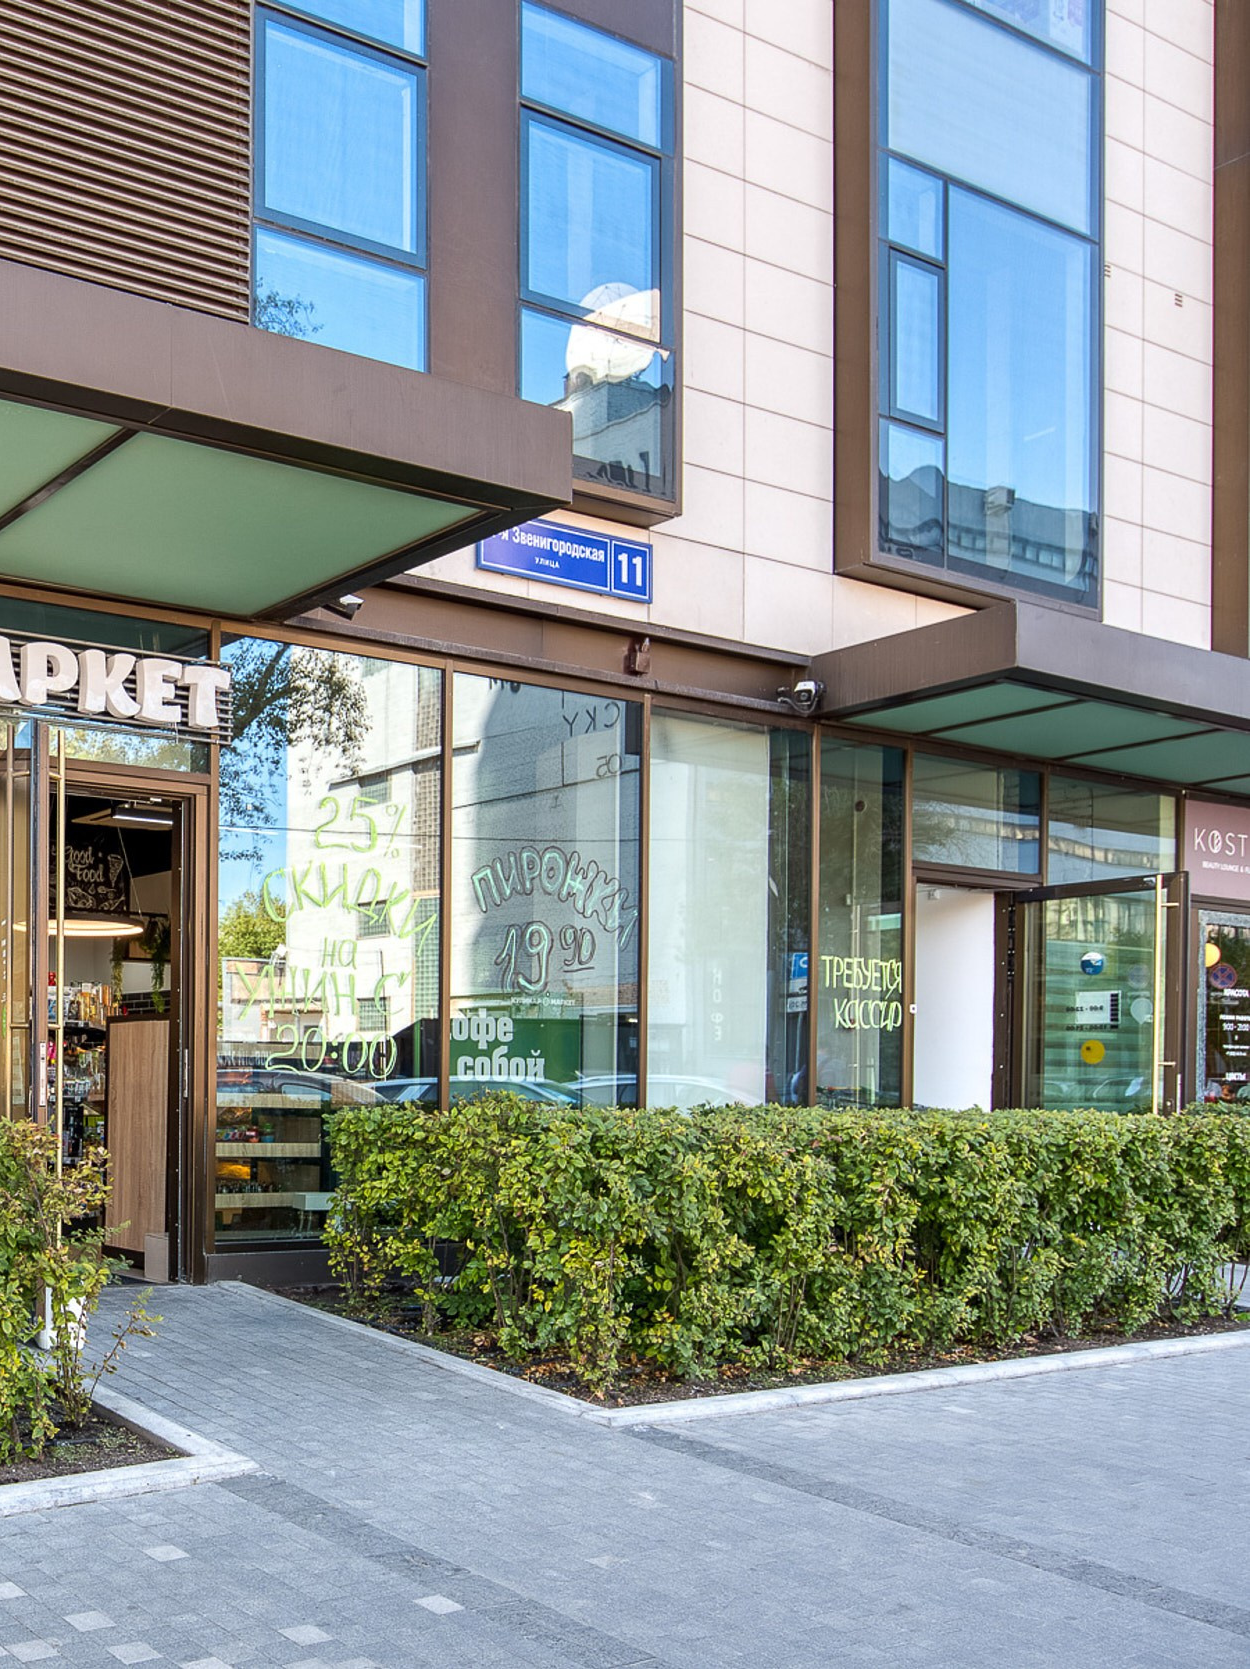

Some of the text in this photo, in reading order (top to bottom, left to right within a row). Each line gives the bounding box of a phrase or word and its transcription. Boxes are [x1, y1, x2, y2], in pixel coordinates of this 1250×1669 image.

[512, 526, 606, 563] Звенигородская
[534, 556, 560, 569] УЛИЦА
[617, 552, 643, 587] 11
[314, 797, 408, 858] 25%
[263, 860, 438, 957] СКИДКИ
[471, 845, 639, 952] ПИРОЖКИ
[821, 955, 902, 996] ТРЕБУЕТСЯ
[449, 1008, 514, 1050] офе
[265, 1024, 398, 1079] 20:00
[456, 1046, 545, 1081] собой
